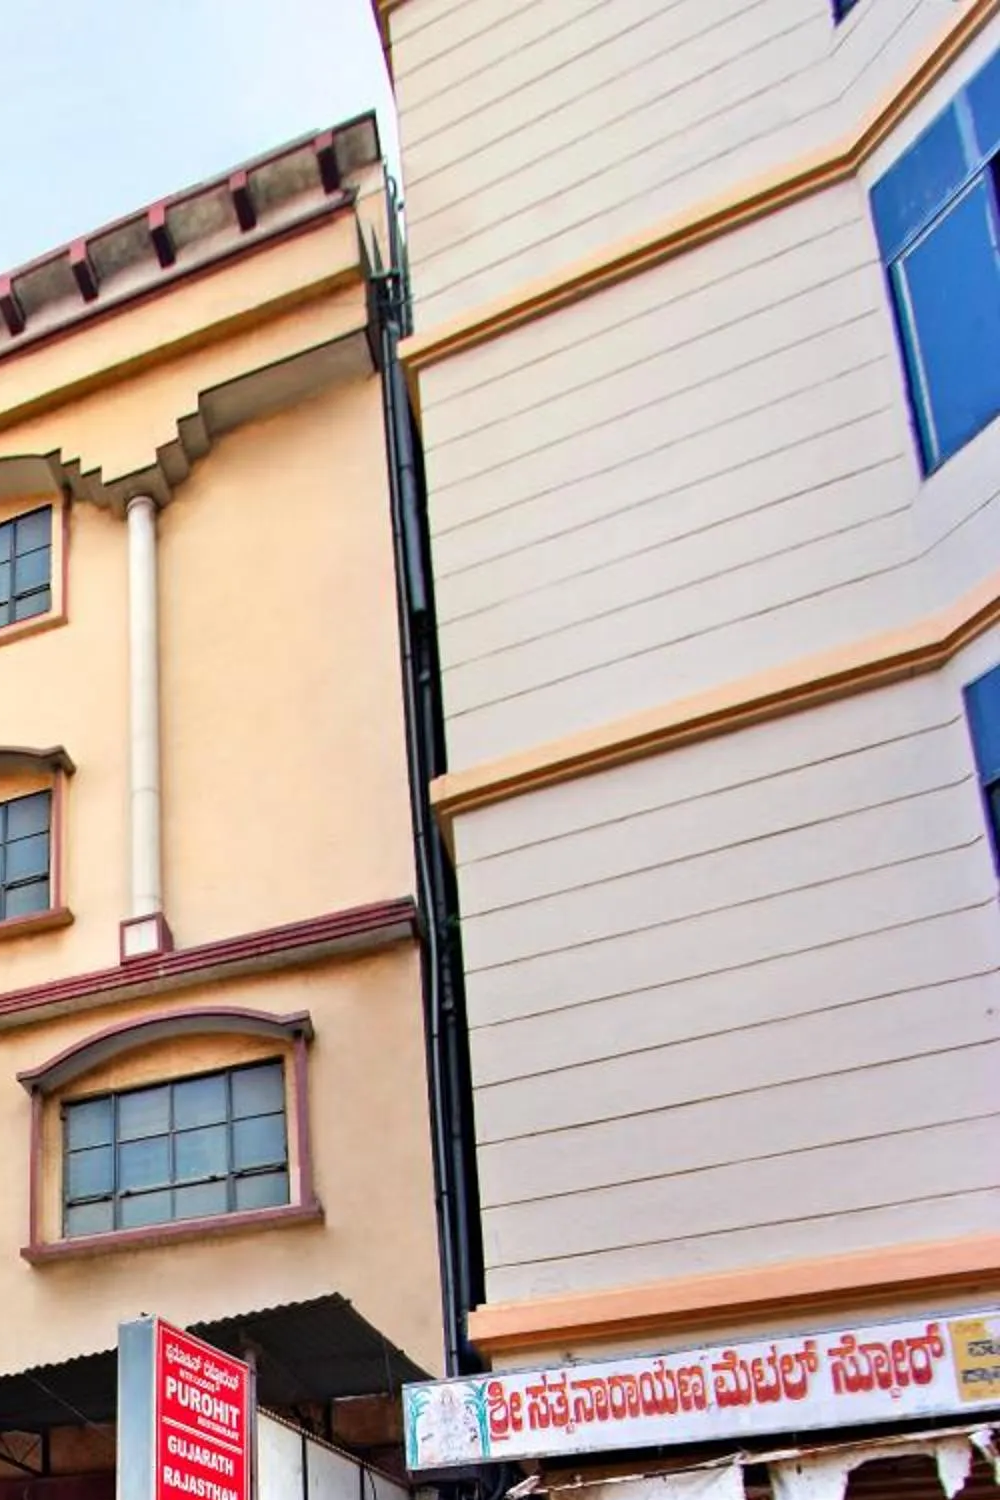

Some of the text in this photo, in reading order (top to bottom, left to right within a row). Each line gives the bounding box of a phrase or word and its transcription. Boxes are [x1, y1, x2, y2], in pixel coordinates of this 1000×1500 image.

[165, 1375, 240, 1429] PUROHIT
[487, 1322, 945, 1441] ಶ್ರೀ ಸತ್ಯನಾರಾಯಣ ಮೆಟಲ್ ಸ್ಟೋರ್
[167, 1435, 234, 1477] GUJARATH
